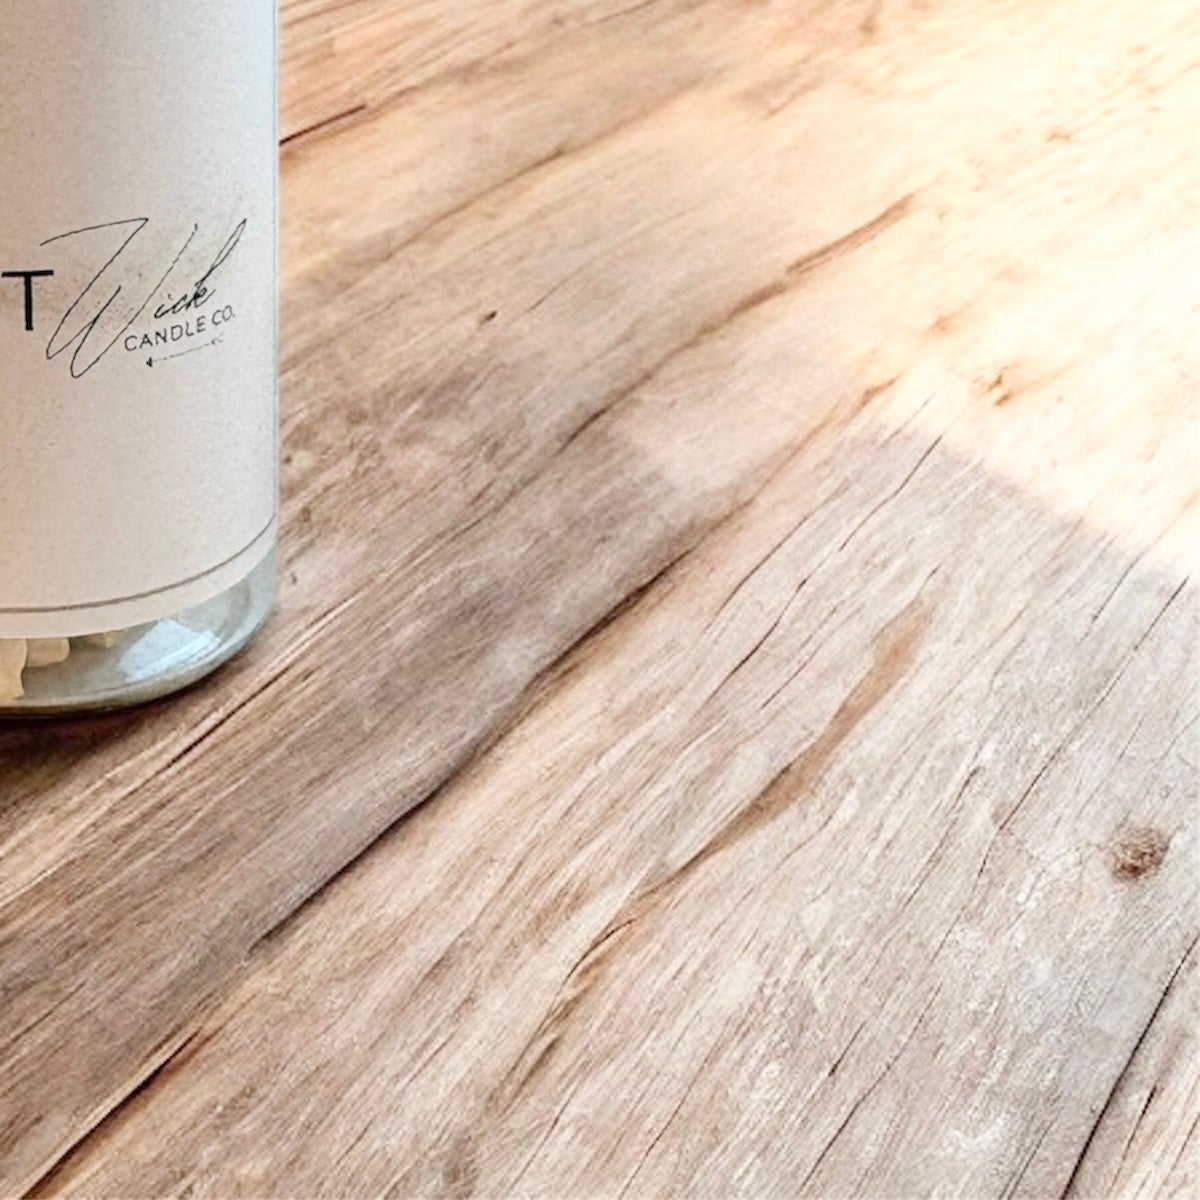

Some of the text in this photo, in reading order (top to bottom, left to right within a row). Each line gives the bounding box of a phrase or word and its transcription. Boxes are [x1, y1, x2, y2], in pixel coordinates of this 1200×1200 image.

[40, 217, 247, 378] Wick
[124, 305, 235, 352] CANDLE CO.
